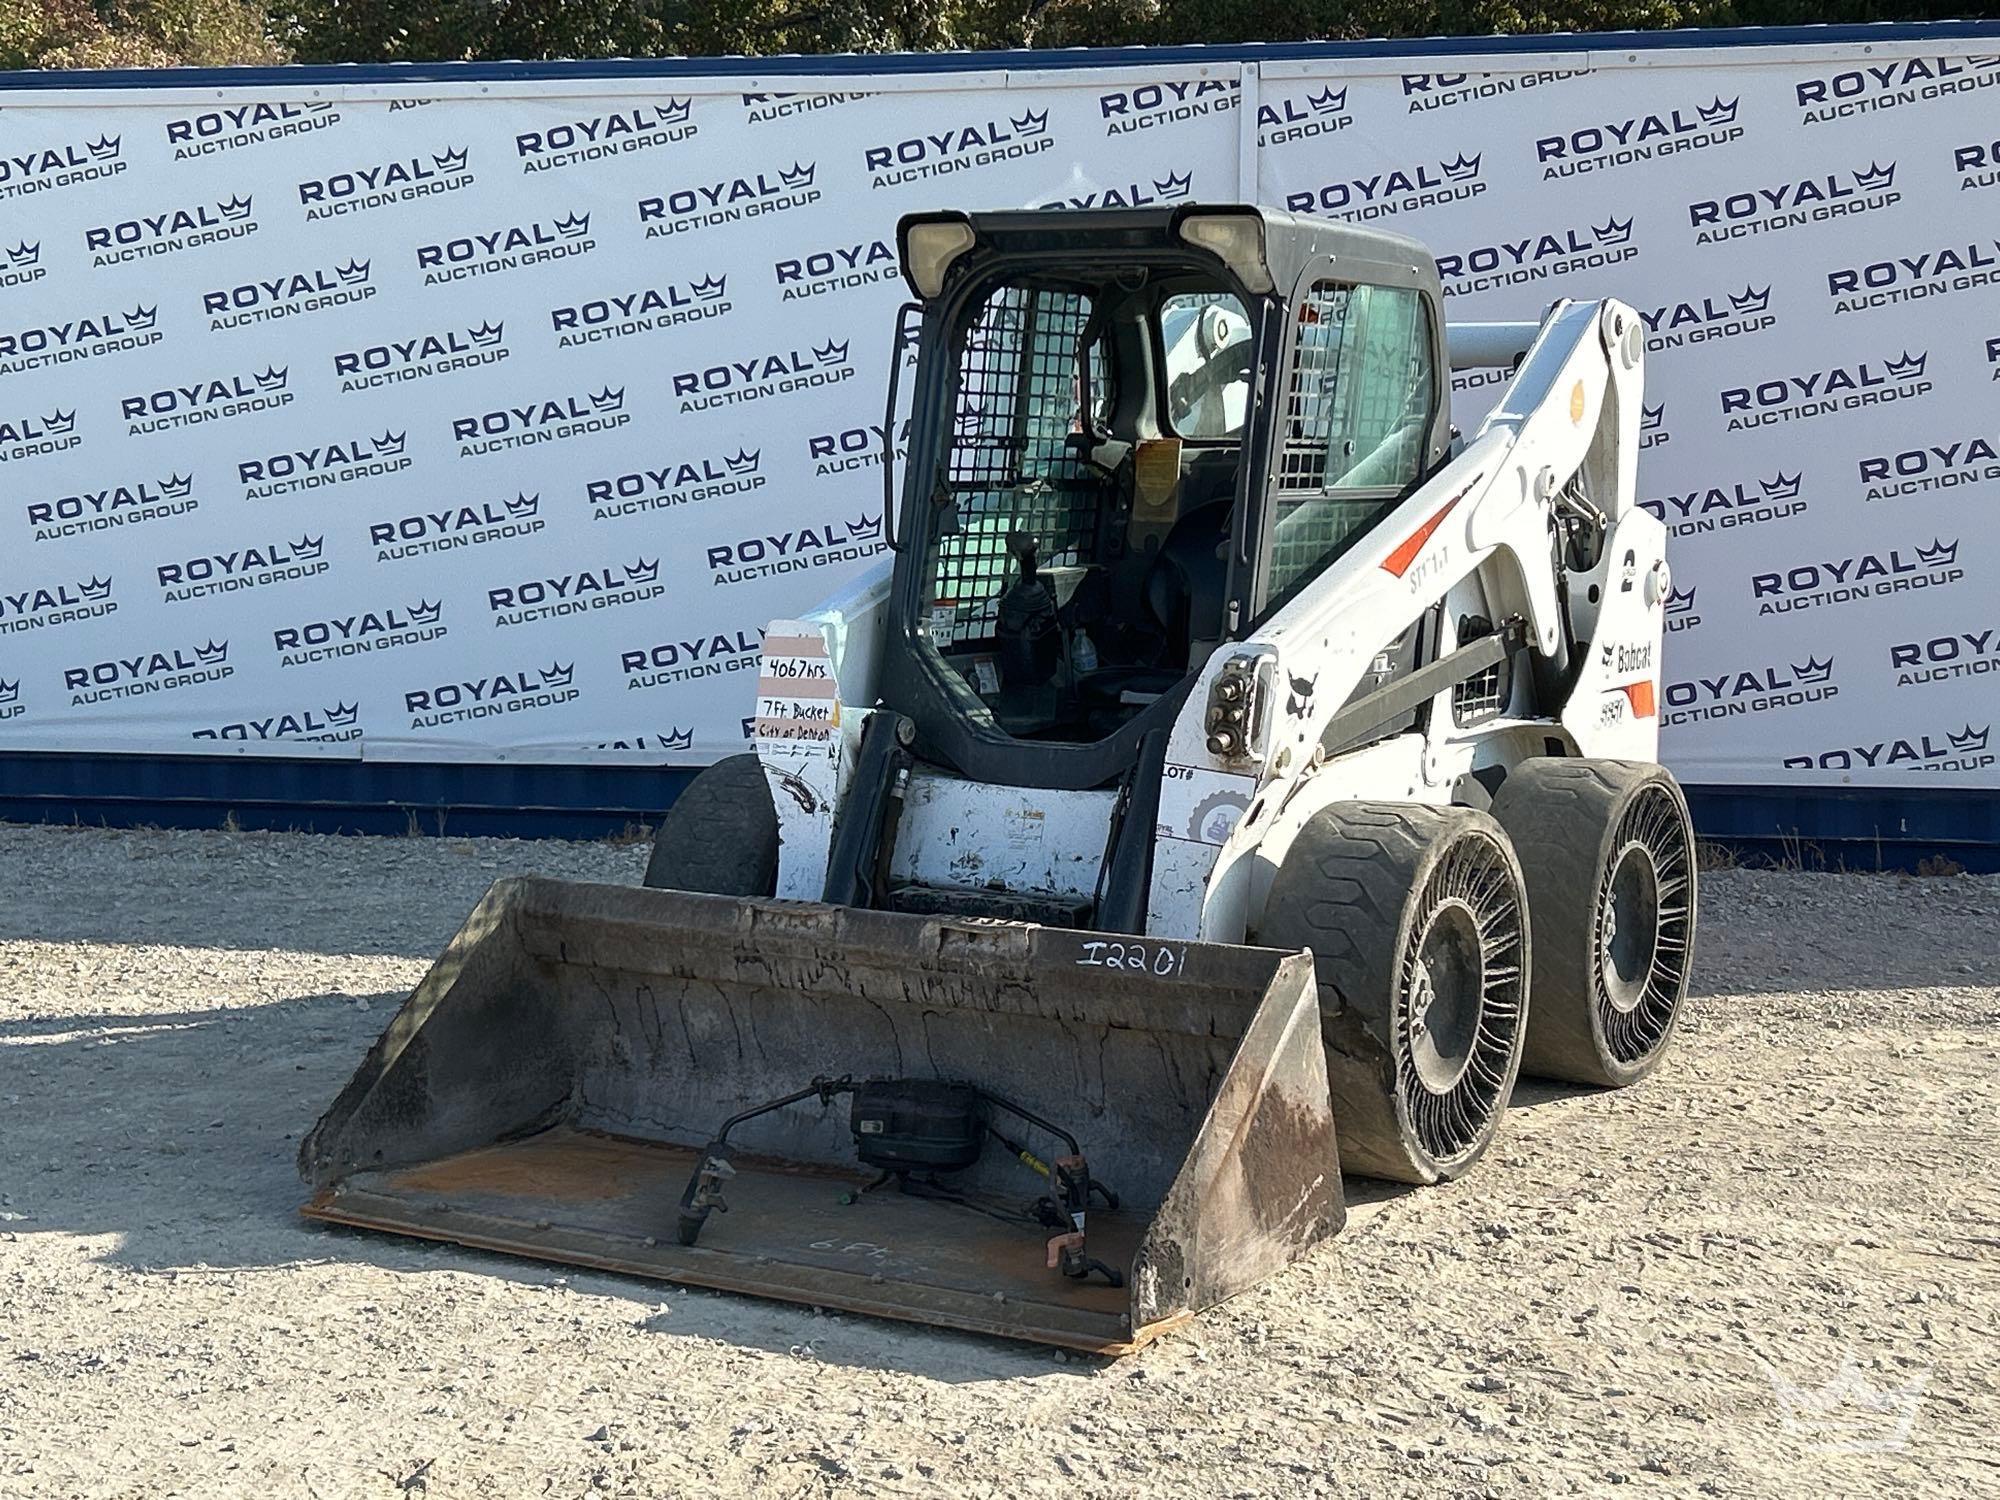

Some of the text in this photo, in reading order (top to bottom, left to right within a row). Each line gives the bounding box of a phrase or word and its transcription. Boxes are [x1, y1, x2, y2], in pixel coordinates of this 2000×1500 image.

[1408, 78, 1516, 115] AUCTION
[1795, 56, 1964, 107] ROYAL
[166, 102, 302, 145] ROYAL
[747, 92, 847, 125] AUCTION
[1106, 101, 1209, 137] AUCTION
[1270, 115, 1354, 145] GROUP
[1802, 89, 1916, 126] AUCTION
[174, 113, 341, 162] AUCTION GROUP
[515, 109, 657, 158] ROYAL
[523, 125, 698, 175] AUCTION GROUP
[864, 121, 1012, 172] ROYAL
[1535, 110, 1698, 163] ROYAL
[1543, 126, 1745, 182] AUCTION GROUP
[55, 161, 128, 187] GROUP
[298, 158, 435, 205] ROYAL
[872, 137, 1055, 190] AUCTION GROUP
[306, 174, 475, 223] AUCTION GROUP
[638, 173, 781, 223] ROYAL
[1286, 165, 1442, 214] ROYAL
[1402, 182, 1487, 212] GROUP
[1688, 174, 1854, 228] ROYAL
[85, 205, 220, 252] ROYAL
[645, 190, 822, 240] AUCTION GROUP
[1695, 192, 1902, 246] AUCTION GROUP
[93, 222, 259, 269] AUCTION GROUP
[416, 223, 556, 270] ROYAL
[424, 239, 596, 287] AUCTION GROUP
[774, 240, 895, 285] ROYA
[1433, 229, 1593, 281] ROYAL
[202, 270, 338, 315] ROYAL
[782, 269, 880, 303] AUCTION
[1441, 246, 1639, 299] AUCTION GROUP
[1827, 244, 1996, 297] ROYAL
[1834, 269, 2000, 315] AUCTION GRO
[210, 286, 377, 332] AUCTION GROUP
[550, 285, 692, 332] ROYAL
[558, 301, 733, 349] AUCTION GROUP
[1688, 315, 1776, 344] GROUP
[0, 315, 125, 359] ROYAL
[0, 331, 163, 376] AUCTION GROUP
[333, 331, 471, 377] ROYAL
[341, 348, 510, 394] AUCTION GROUP
[672, 350, 814, 398] ROYAL
[679, 367, 855, 415] AUCTION GROUP
[1451, 368, 1516, 392] ROUP
[1720, 363, 1886, 415] ROYAL
[121, 376, 256, 421] ROYAL
[128, 392, 295, 437] AUCTION GROUP
[452, 396, 591, 442] ROYAL
[1726, 381, 1933, 433] AUCTION GROUP
[11, 435, 82, 460] GROUP
[460, 413, 631, 459] AUCTION GROUP
[237, 440, 374, 485] ROYAL
[245, 457, 413, 501] AUCTION GROUP
[586, 459, 726, 504] ROYAL
[1858, 438, 1999, 484] ROYA
[27, 483, 161, 526] ROYAL
[593, 476, 766, 521] AUCTION GROUP
[1865, 469, 1979, 502] AUCTION
[34, 499, 199, 543] AUCTION GROUP
[369, 503, 506, 547] ROYAL
[1719, 501, 1808, 529] GROUP
[377, 519, 546, 563] AUCTION GROUP
[706, 524, 848, 570] ROYAL
[156, 545, 291, 587] ROYAL
[164, 561, 330, 604] AUCTION GROUP
[713, 542, 888, 587] AUCTION GROUP
[1751, 550, 1917, 599] ROYAL
[487, 568, 626, 612] ROYAL
[495, 585, 665, 628] AUCTION GROUP
[1758, 568, 1964, 617] AUCTION GROUP
[47, 602, 118, 626] GROUP
[273, 609, 409, 652] ROYAL
[281, 626, 448, 668] AUCTION GROUP
[620, 631, 760, 674] ROYAL
[1618, 640, 1651, 673] Bobcat
[63, 649, 196, 691] ROYAL
[71, 666, 235, 707] AUCTION GROUP
[404, 672, 541, 713] ROYAL
[627, 662, 722, 691] AUCTION
[1665, 667, 1793, 707] OYAL
[410, 689, 580, 730] AUCTION GROUP
[793, 702, 830, 721] Bucket
[1751, 686, 1839, 712] GROUP
[759, 724, 780, 738] City
